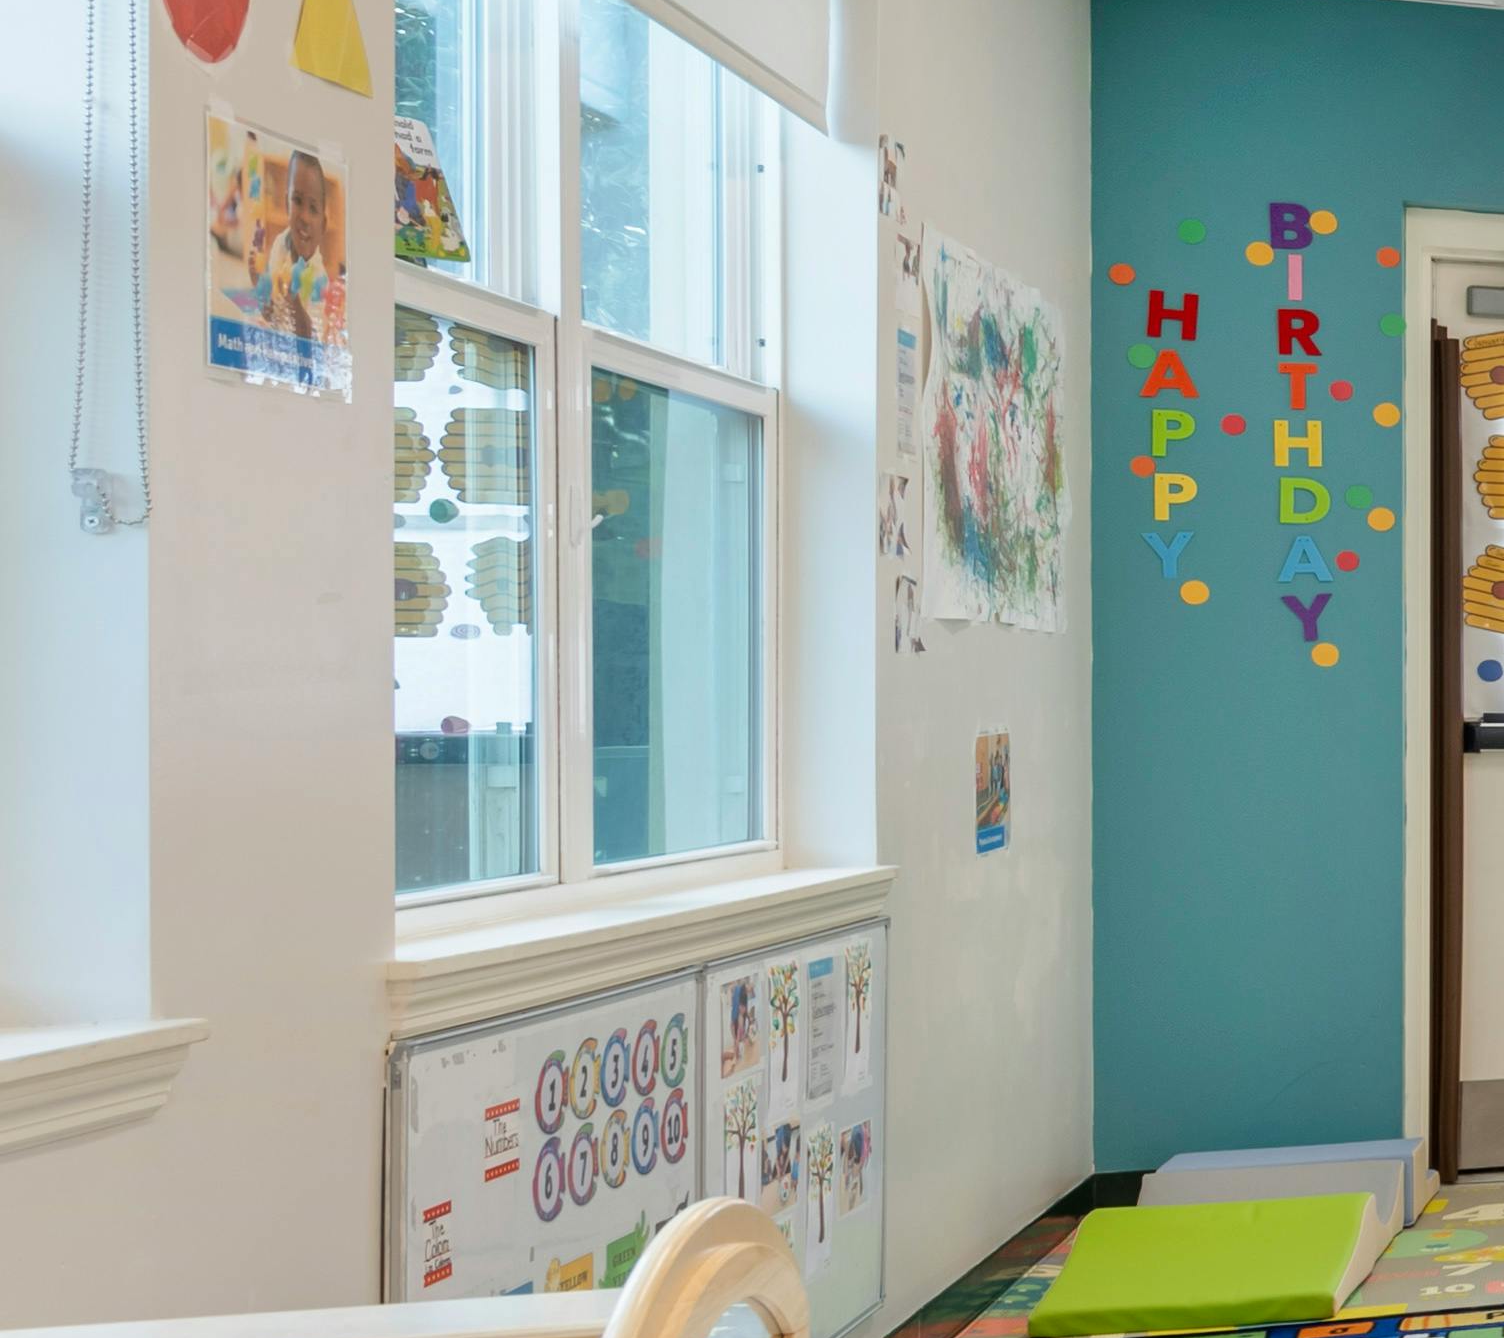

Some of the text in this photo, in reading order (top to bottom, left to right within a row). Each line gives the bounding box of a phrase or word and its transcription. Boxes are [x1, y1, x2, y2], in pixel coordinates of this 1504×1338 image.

[217, 332, 244, 353] Math
[1141, 289, 1201, 580] HAPPY
[1268, 201, 1334, 642] BIRTHDAY
[639, 1047, 651, 1079] 4
[668, 1039, 677, 1070] 5
[579, 1066, 589, 1096] 2
[609, 1054, 620, 1088] 3
[548, 1079, 557, 1111] 1
[492, 1119, 508, 1135] The
[641, 1123, 650, 1155] 9
[667, 1114, 681, 1145] 10
[610, 1132, 619, 1166] 8
[545, 1162, 553, 1200] 6
[579, 1150, 588, 1187] 7
[1441, 1261, 1493, 1276] 7
[1420, 1283, 1477, 1295] 10
